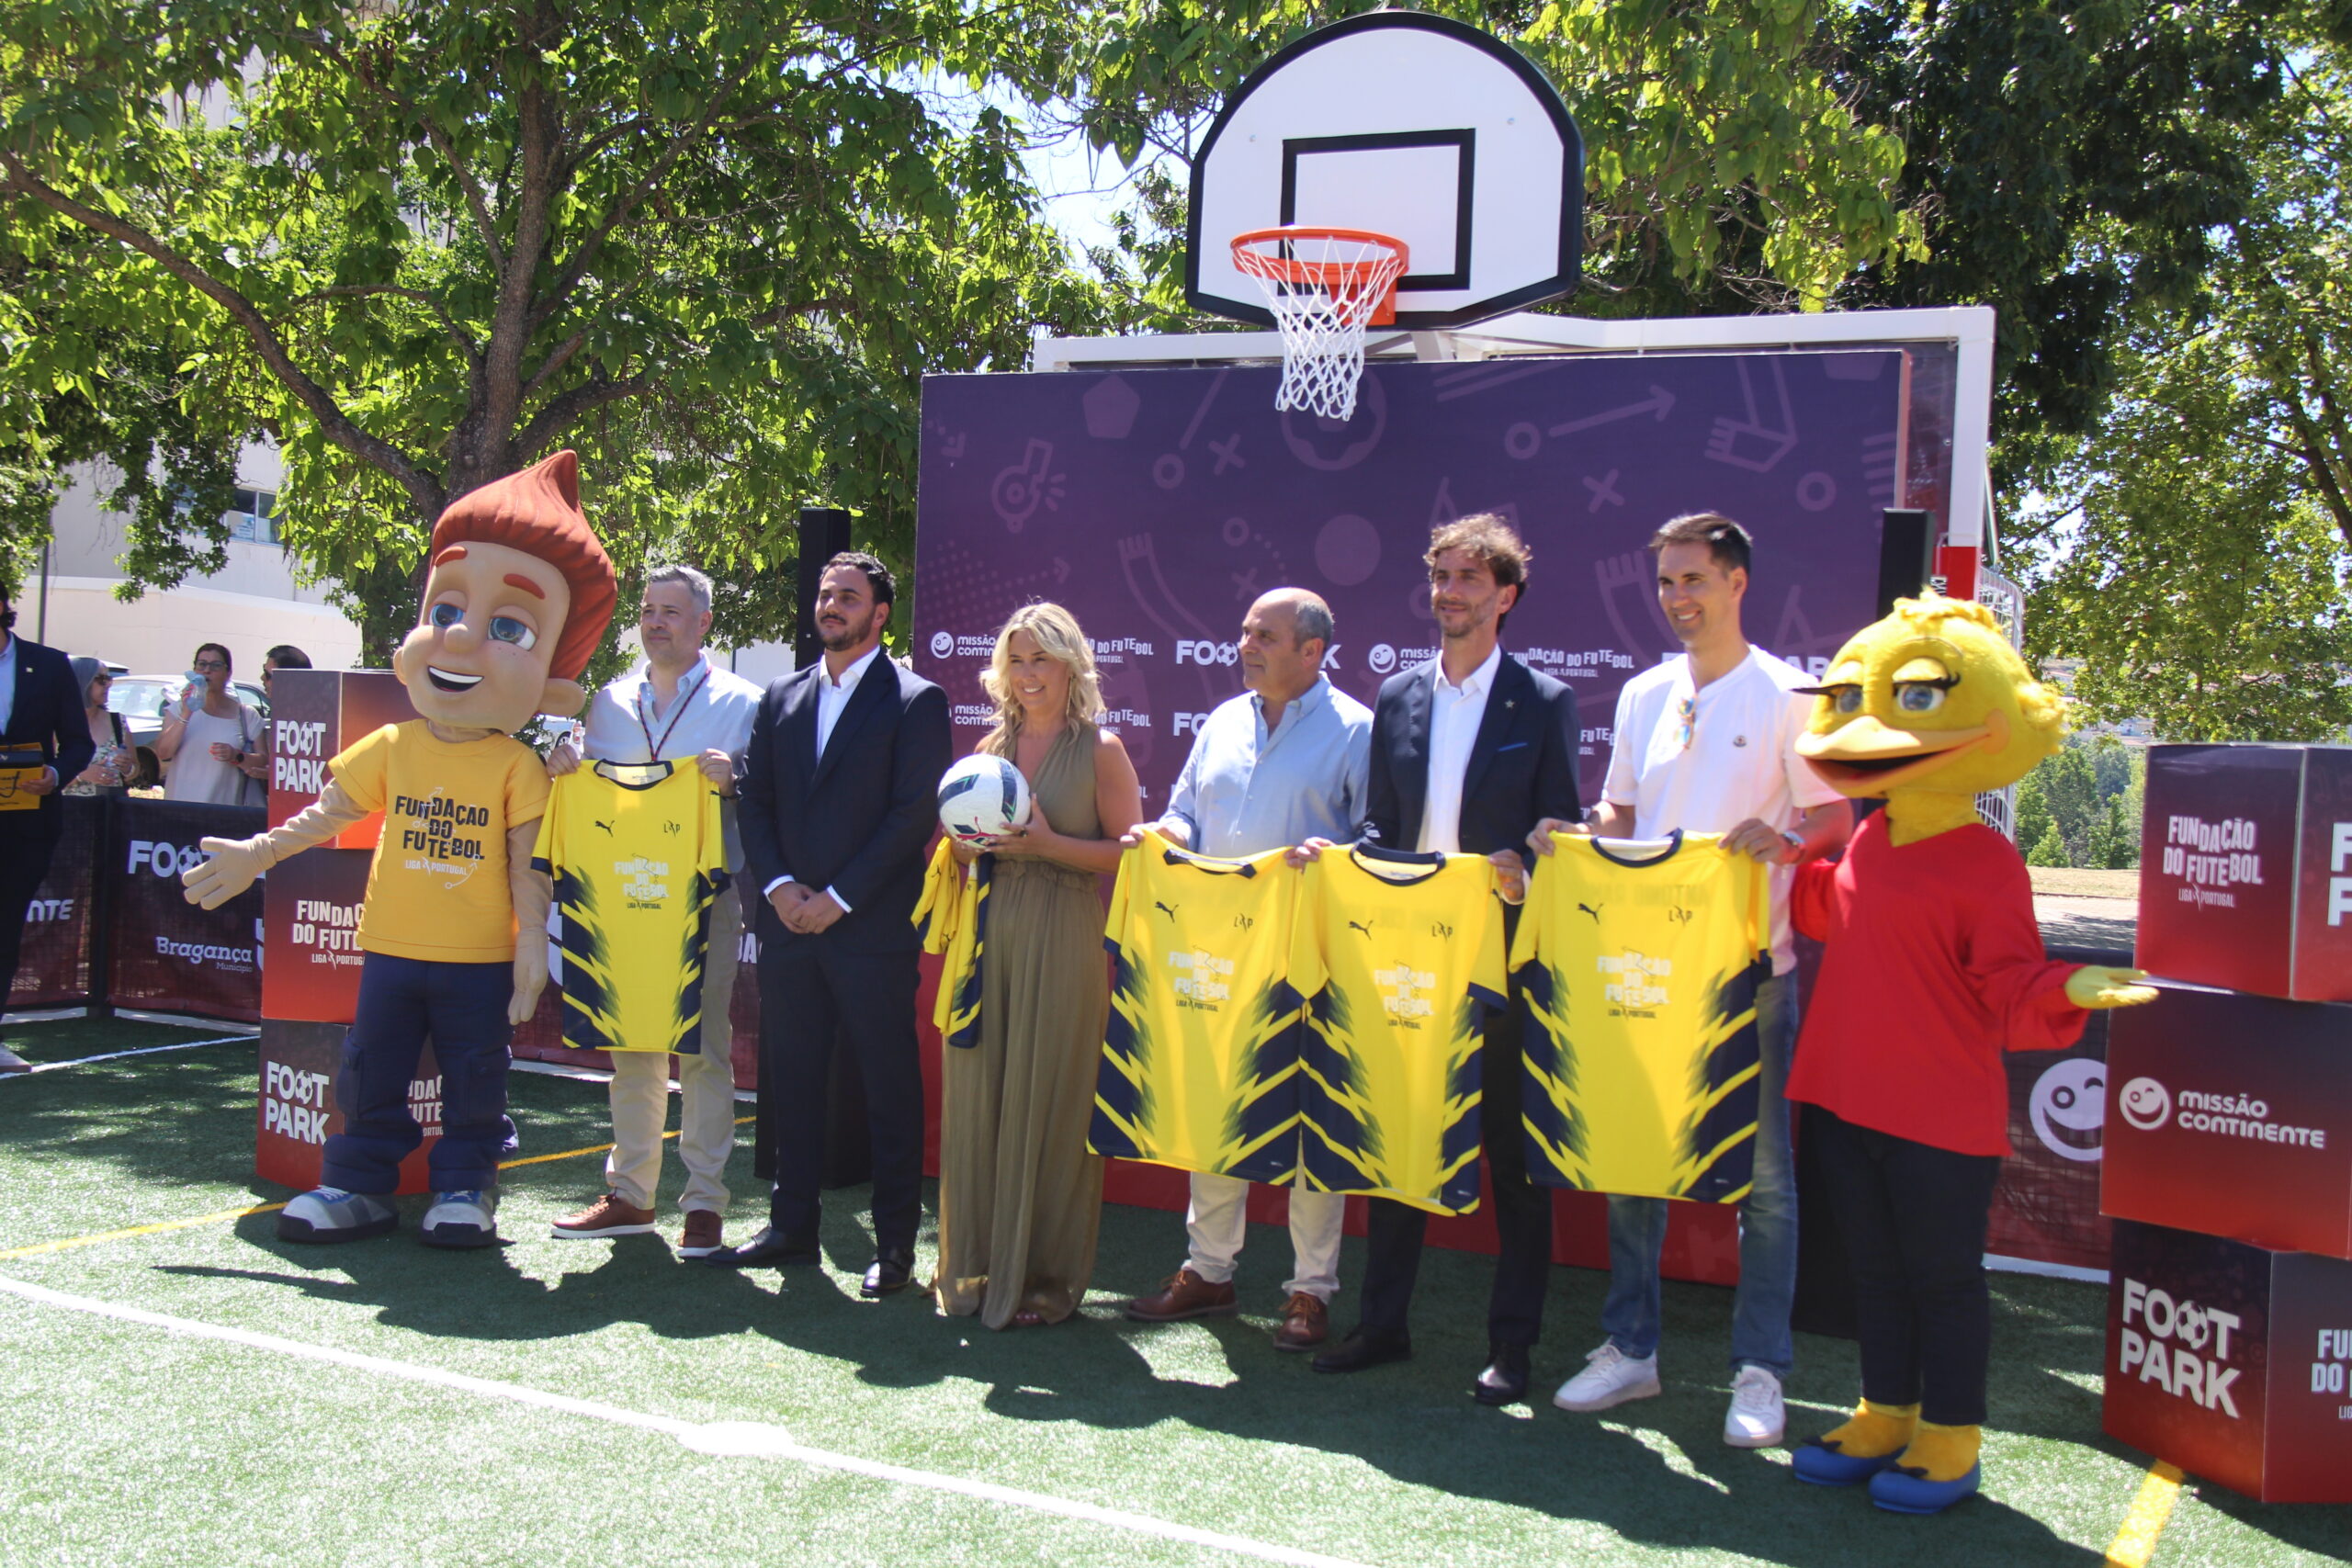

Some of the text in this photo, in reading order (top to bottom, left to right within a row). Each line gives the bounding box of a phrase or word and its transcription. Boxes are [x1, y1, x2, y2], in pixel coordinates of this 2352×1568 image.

[1097, 641, 1110, 654] DO
[1111, 637, 1154, 655] FUTEBOL
[1400, 646, 1437, 659] MISSÃ
[1566, 654, 1581, 667] DO
[1583, 649, 1634, 669] FUTEBOL
[956, 704, 993, 715] MISSÃO
[1109, 709, 1151, 727] FUTEBOL
[276, 757, 327, 794] PARK
[428, 818, 454, 840] DO
[2167, 815, 2256, 853] FUNDAÇÃO
[403, 830, 485, 859] FUTEBOL
[405, 860, 468, 875] LIGA PORTUGAL
[2163, 847, 2264, 887] DO FUTEBOL
[2178, 888, 2235, 908] LIGA PORTUGAL
[155, 936, 253, 964] Bragança
[292, 923, 364, 952] DO FUTE
[311, 953, 327, 964] LIGA
[2178, 1090, 2267, 1119] MISSÃO
[266, 1097, 330, 1146] PARK
[2177, 1111, 2325, 1148] CONTINENTE
[2120, 1327, 2241, 1419] PARK
[2311, 1362, 2343, 1393] DO
